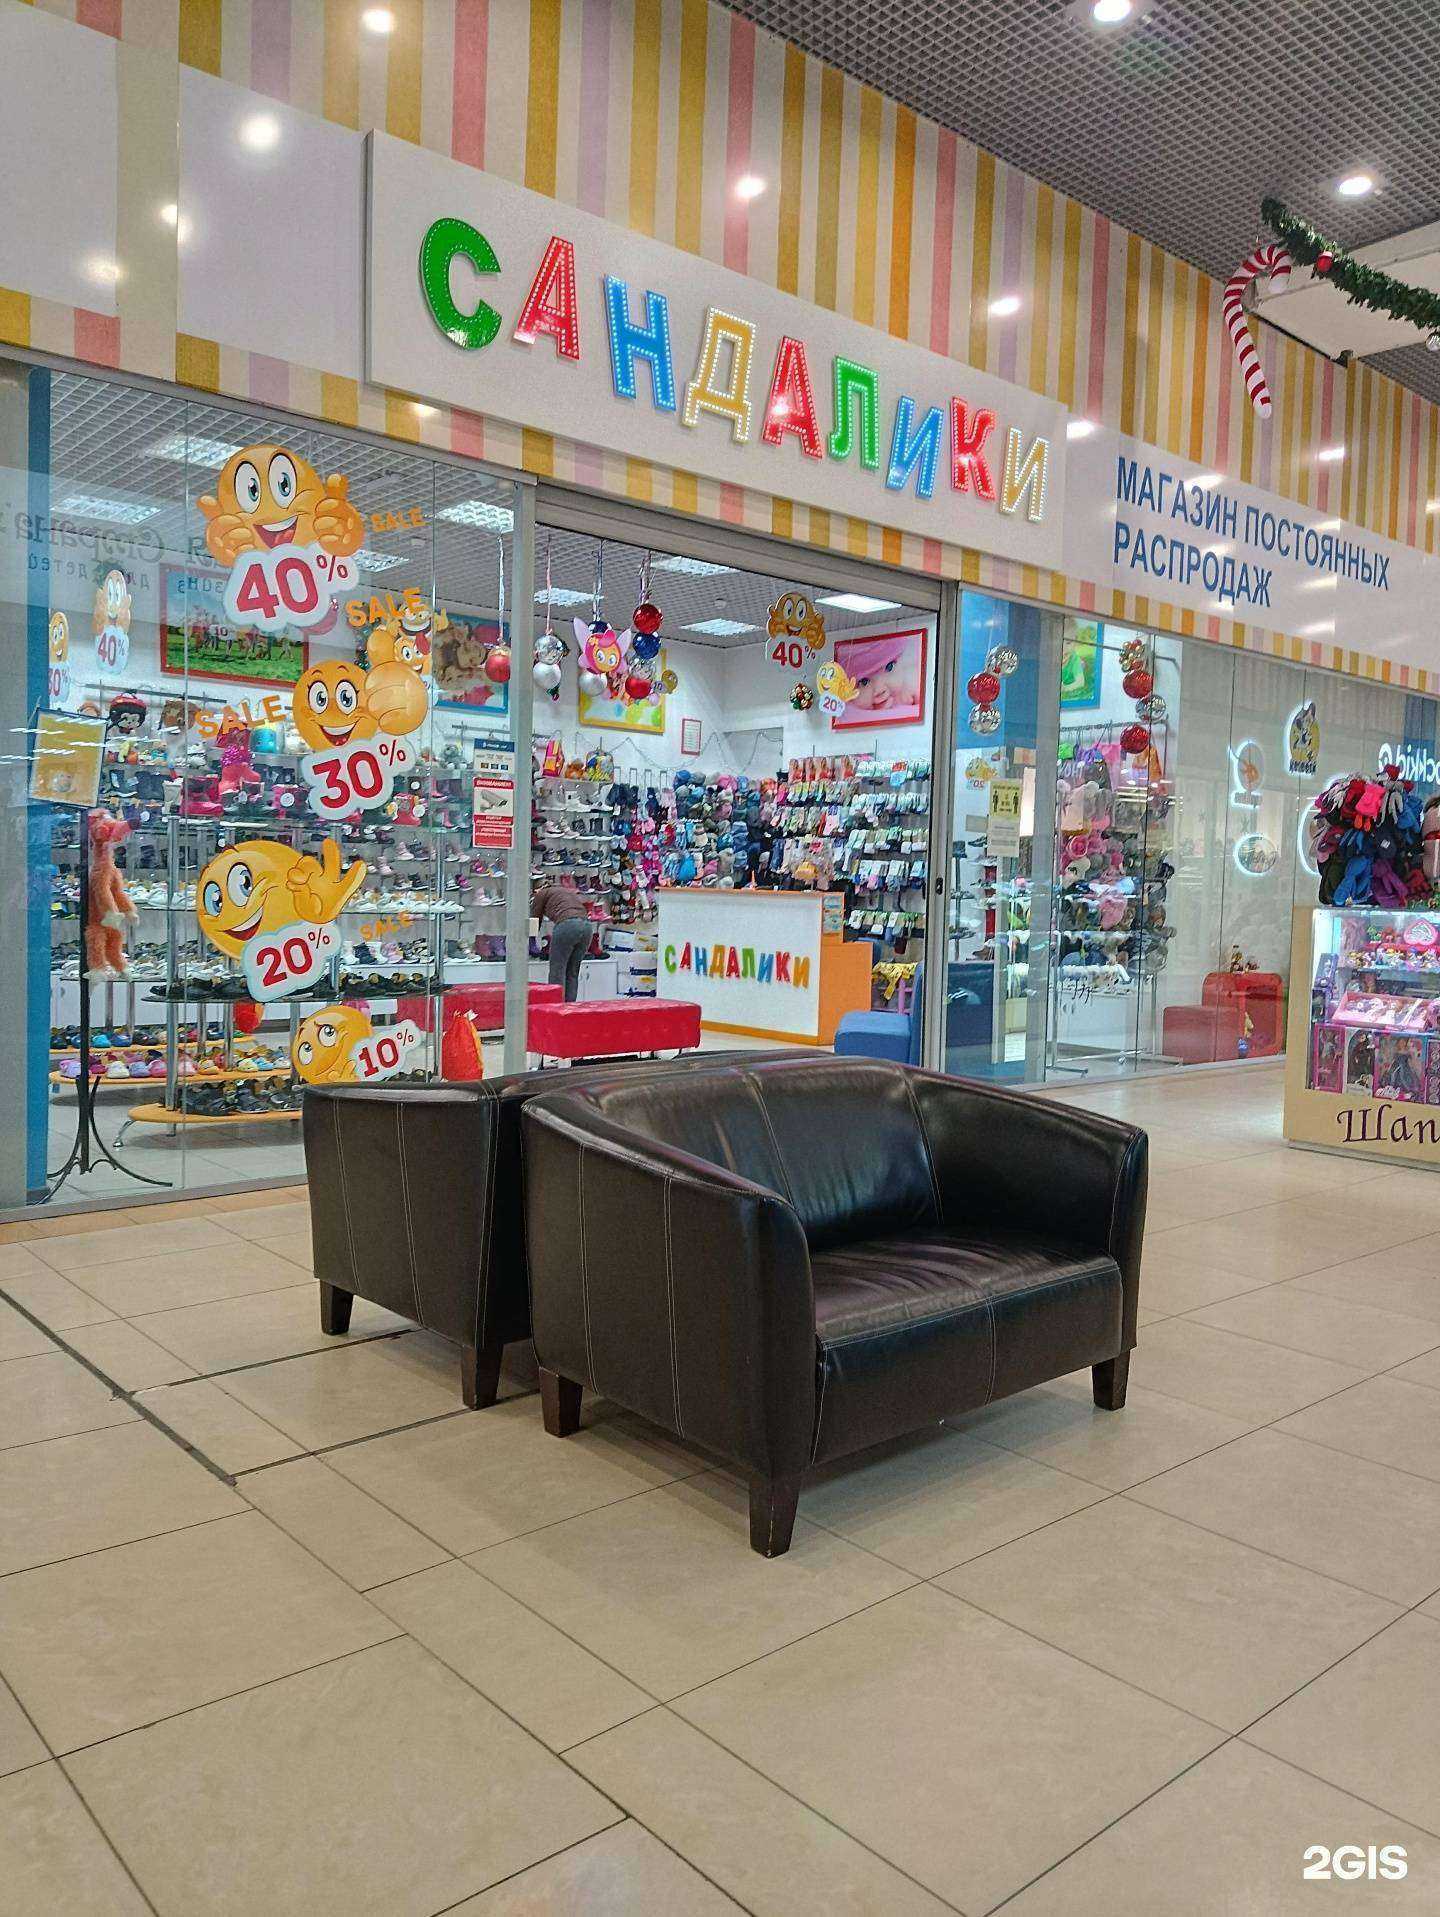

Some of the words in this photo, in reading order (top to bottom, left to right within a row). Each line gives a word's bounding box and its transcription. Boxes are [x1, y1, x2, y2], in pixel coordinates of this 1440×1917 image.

[419, 216, 1051, 523] САНДАЛИКИ
[371, 506, 426, 533] SALE
[1115, 455, 1239, 540] МАГАЗИН
[1244, 504, 1391, 591] ПОСТОЯННЫХ
[236, 553, 350, 619] 40%
[1113, 520, 1273, 608] РАСПРОДАЖ
[345, 586, 428, 628] SALE
[771, 641, 816, 669] 40%
[194, 694, 287, 739] SALE
[312, 739, 407, 809] 30%
[358, 910, 414, 941] SALE
[256, 927, 331, 988] 20%
[664, 941, 811, 990] САНДАЛИКИ
[358, 1028, 414, 1078] 10%
